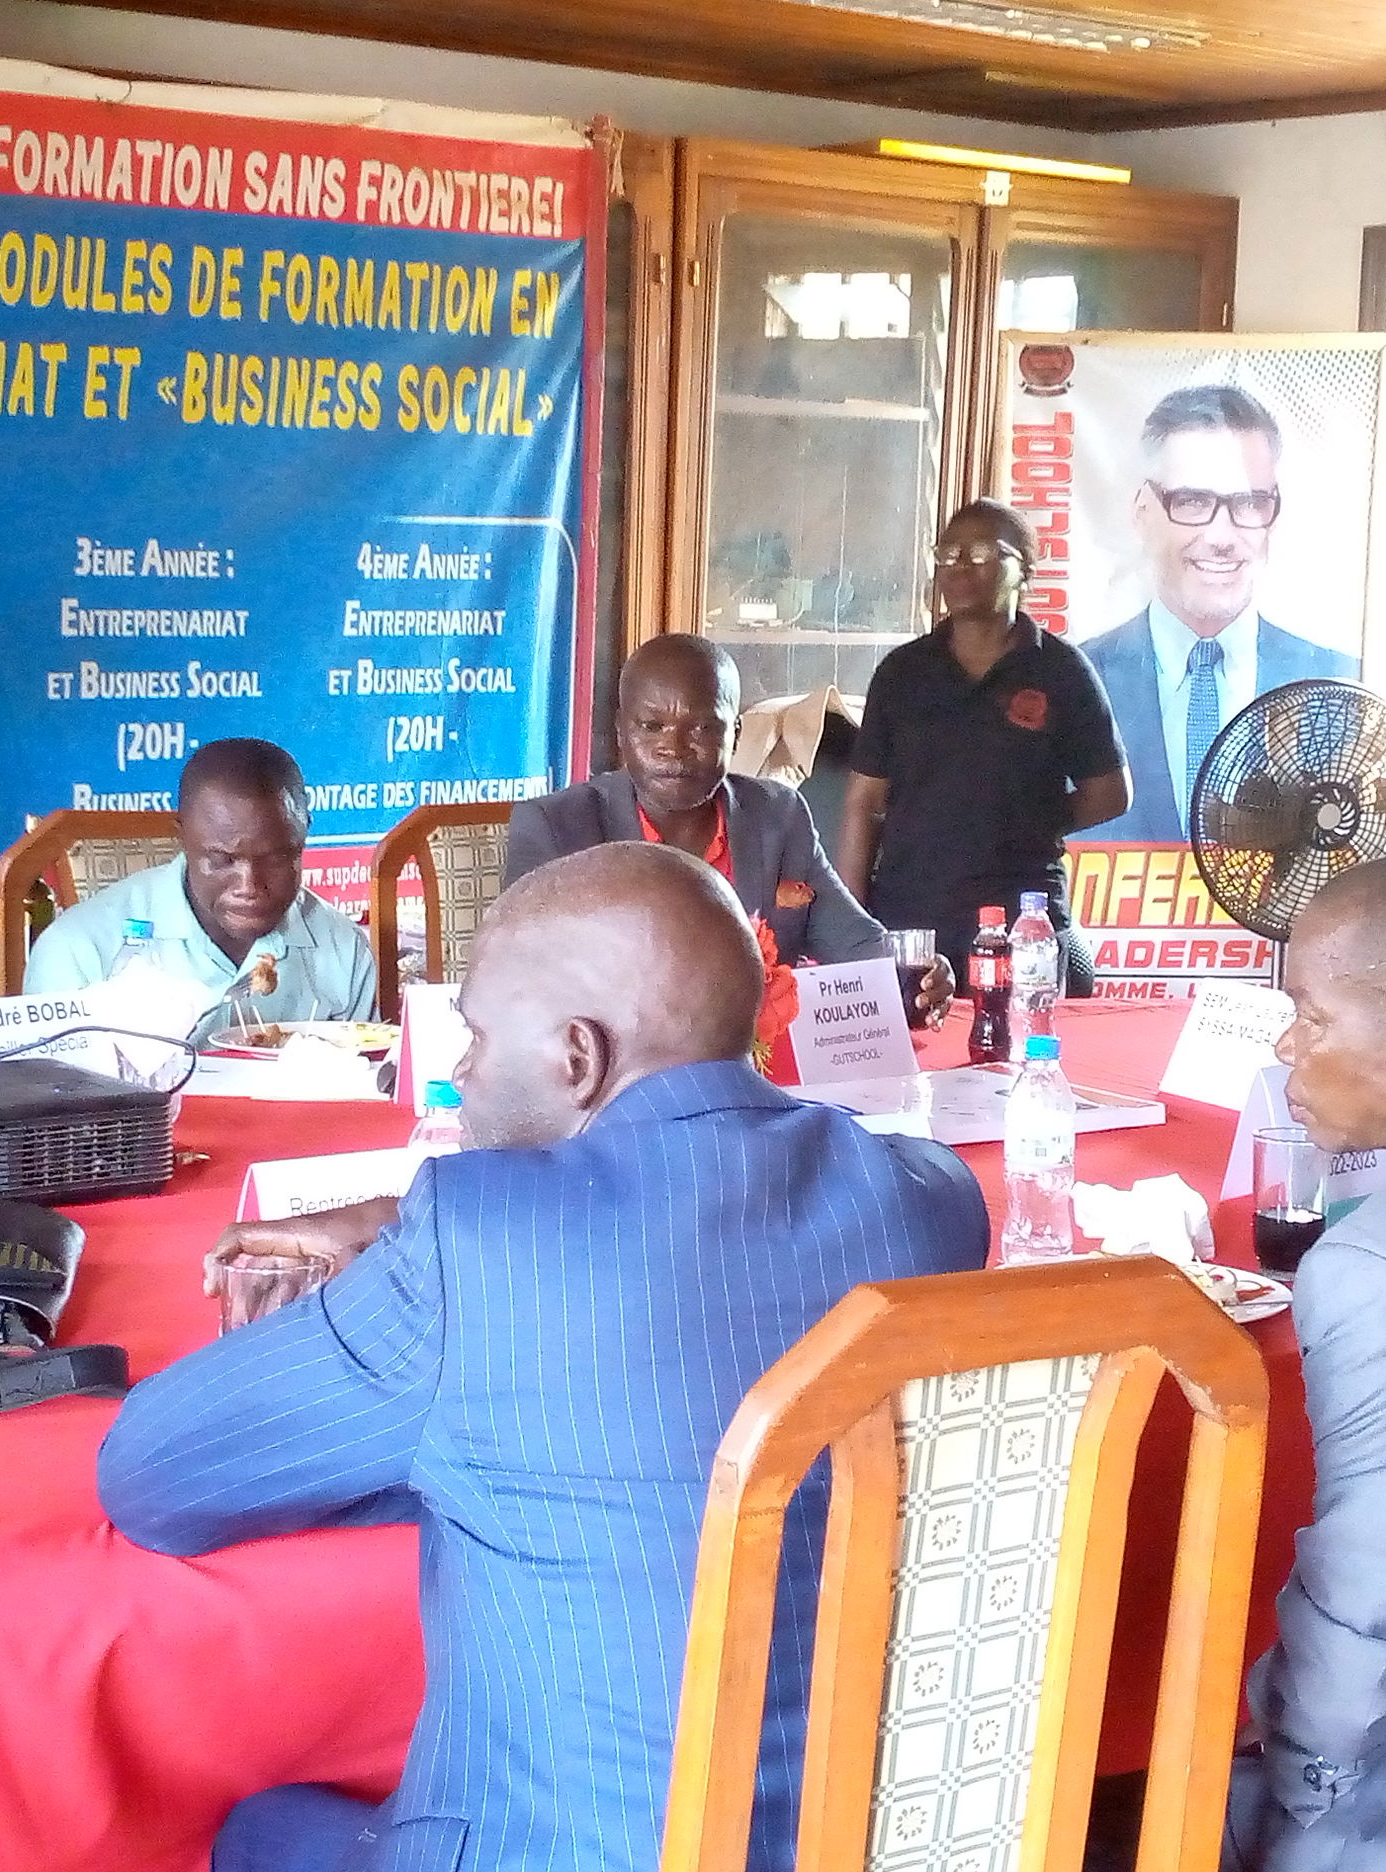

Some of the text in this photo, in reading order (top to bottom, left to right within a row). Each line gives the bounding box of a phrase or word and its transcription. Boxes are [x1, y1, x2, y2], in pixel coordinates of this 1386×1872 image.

[243, 150, 345, 219] SANS
[356, 161, 564, 239] FRONTIERE!
[189, 244, 243, 322] DE
[258, 248, 497, 336] FORMATION
[511, 268, 561, 340] EN
[83, 344, 142, 422] ET
[156, 350, 381, 430] «BUSINESS
[397, 362, 555, 437] SOCIAL»
[60, 598, 249, 637] ENTREPRENARIAT
[344, 600, 505, 637] ENTREPRENARIAT
[47, 661, 263, 699] ET BUSINESS SOCIAL
[329, 657, 516, 696] ET BUSINESS SOCIAL
[117, 722, 185, 772] (20H
[387, 716, 444, 763] (20H
[305, 783, 377, 812] ONTAGE
[383, 780, 415, 808] DES
[819, 975, 864, 997] Pr Henri
[26, 1000, 91, 1024] BOBAL
[813, 1001, 880, 1025] KOULAYOM
